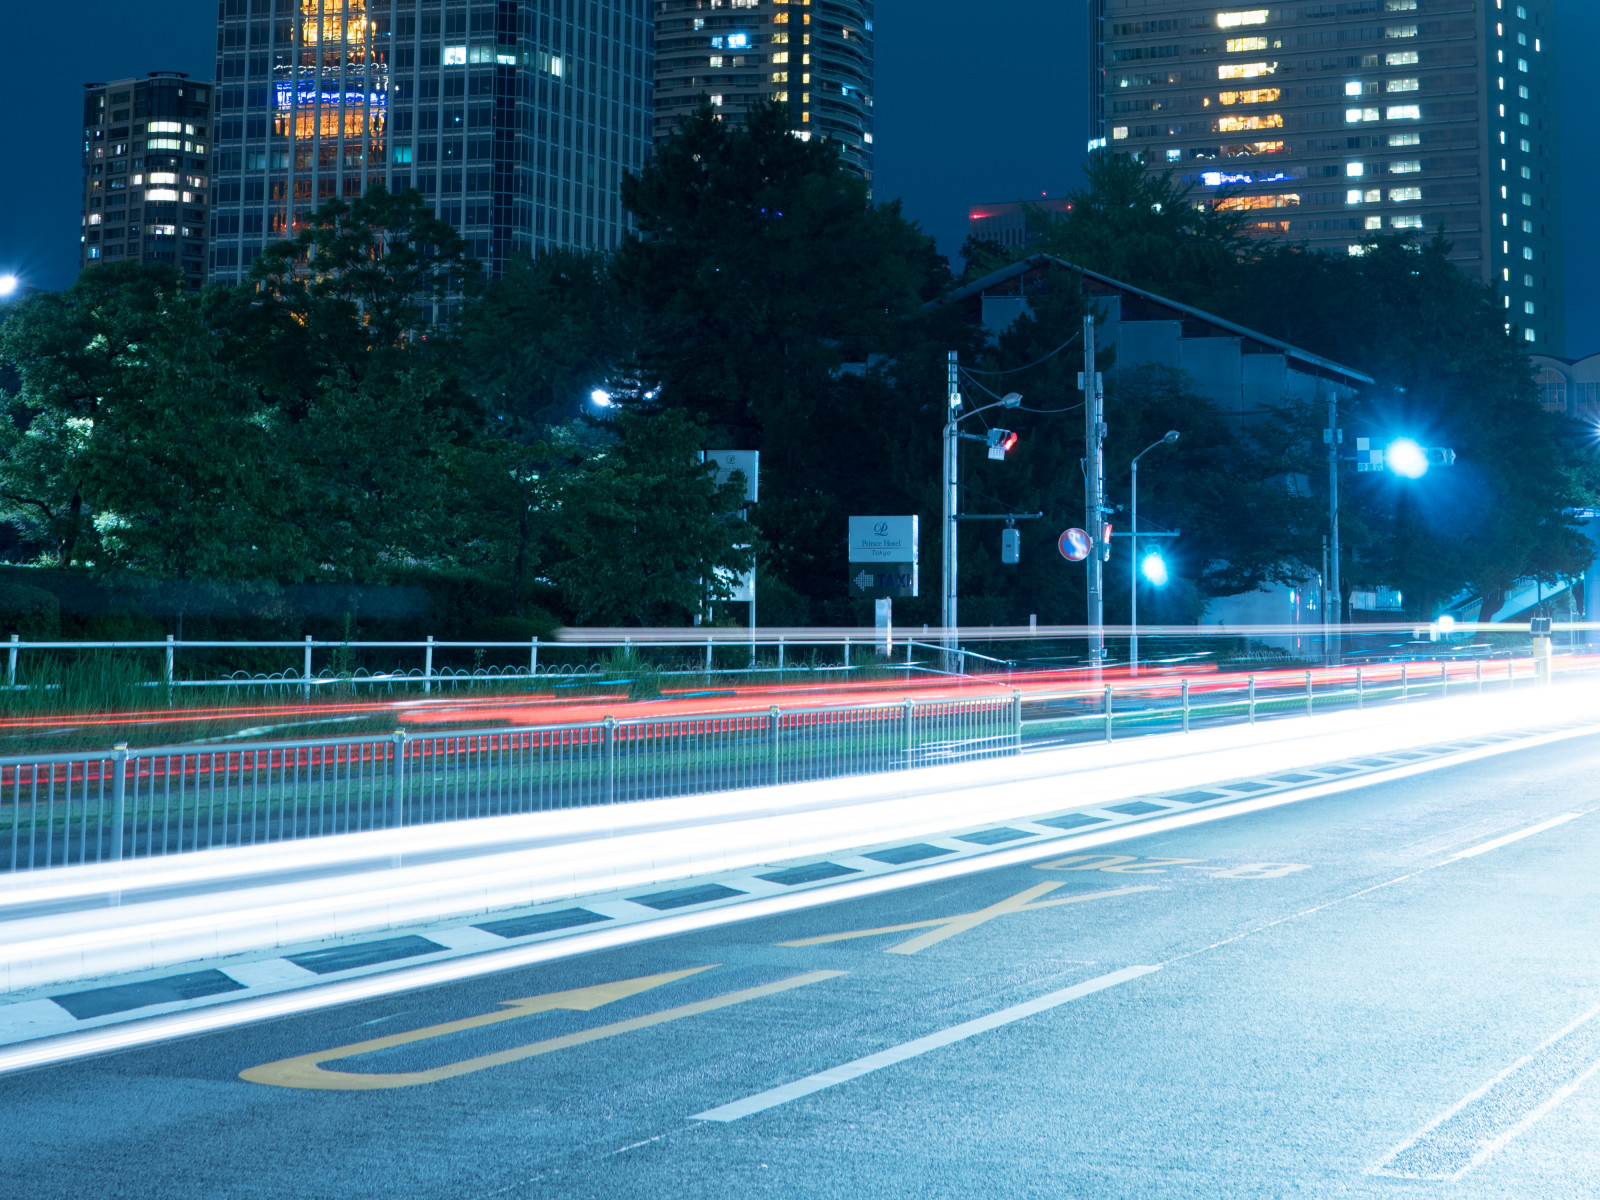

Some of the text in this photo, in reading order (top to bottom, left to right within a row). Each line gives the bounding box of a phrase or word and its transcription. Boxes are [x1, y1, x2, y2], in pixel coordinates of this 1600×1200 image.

[861, 539, 901, 547] Prince Hotel
[871, 549, 892, 557] Tokyo
[877, 573, 911, 588] TAXI
